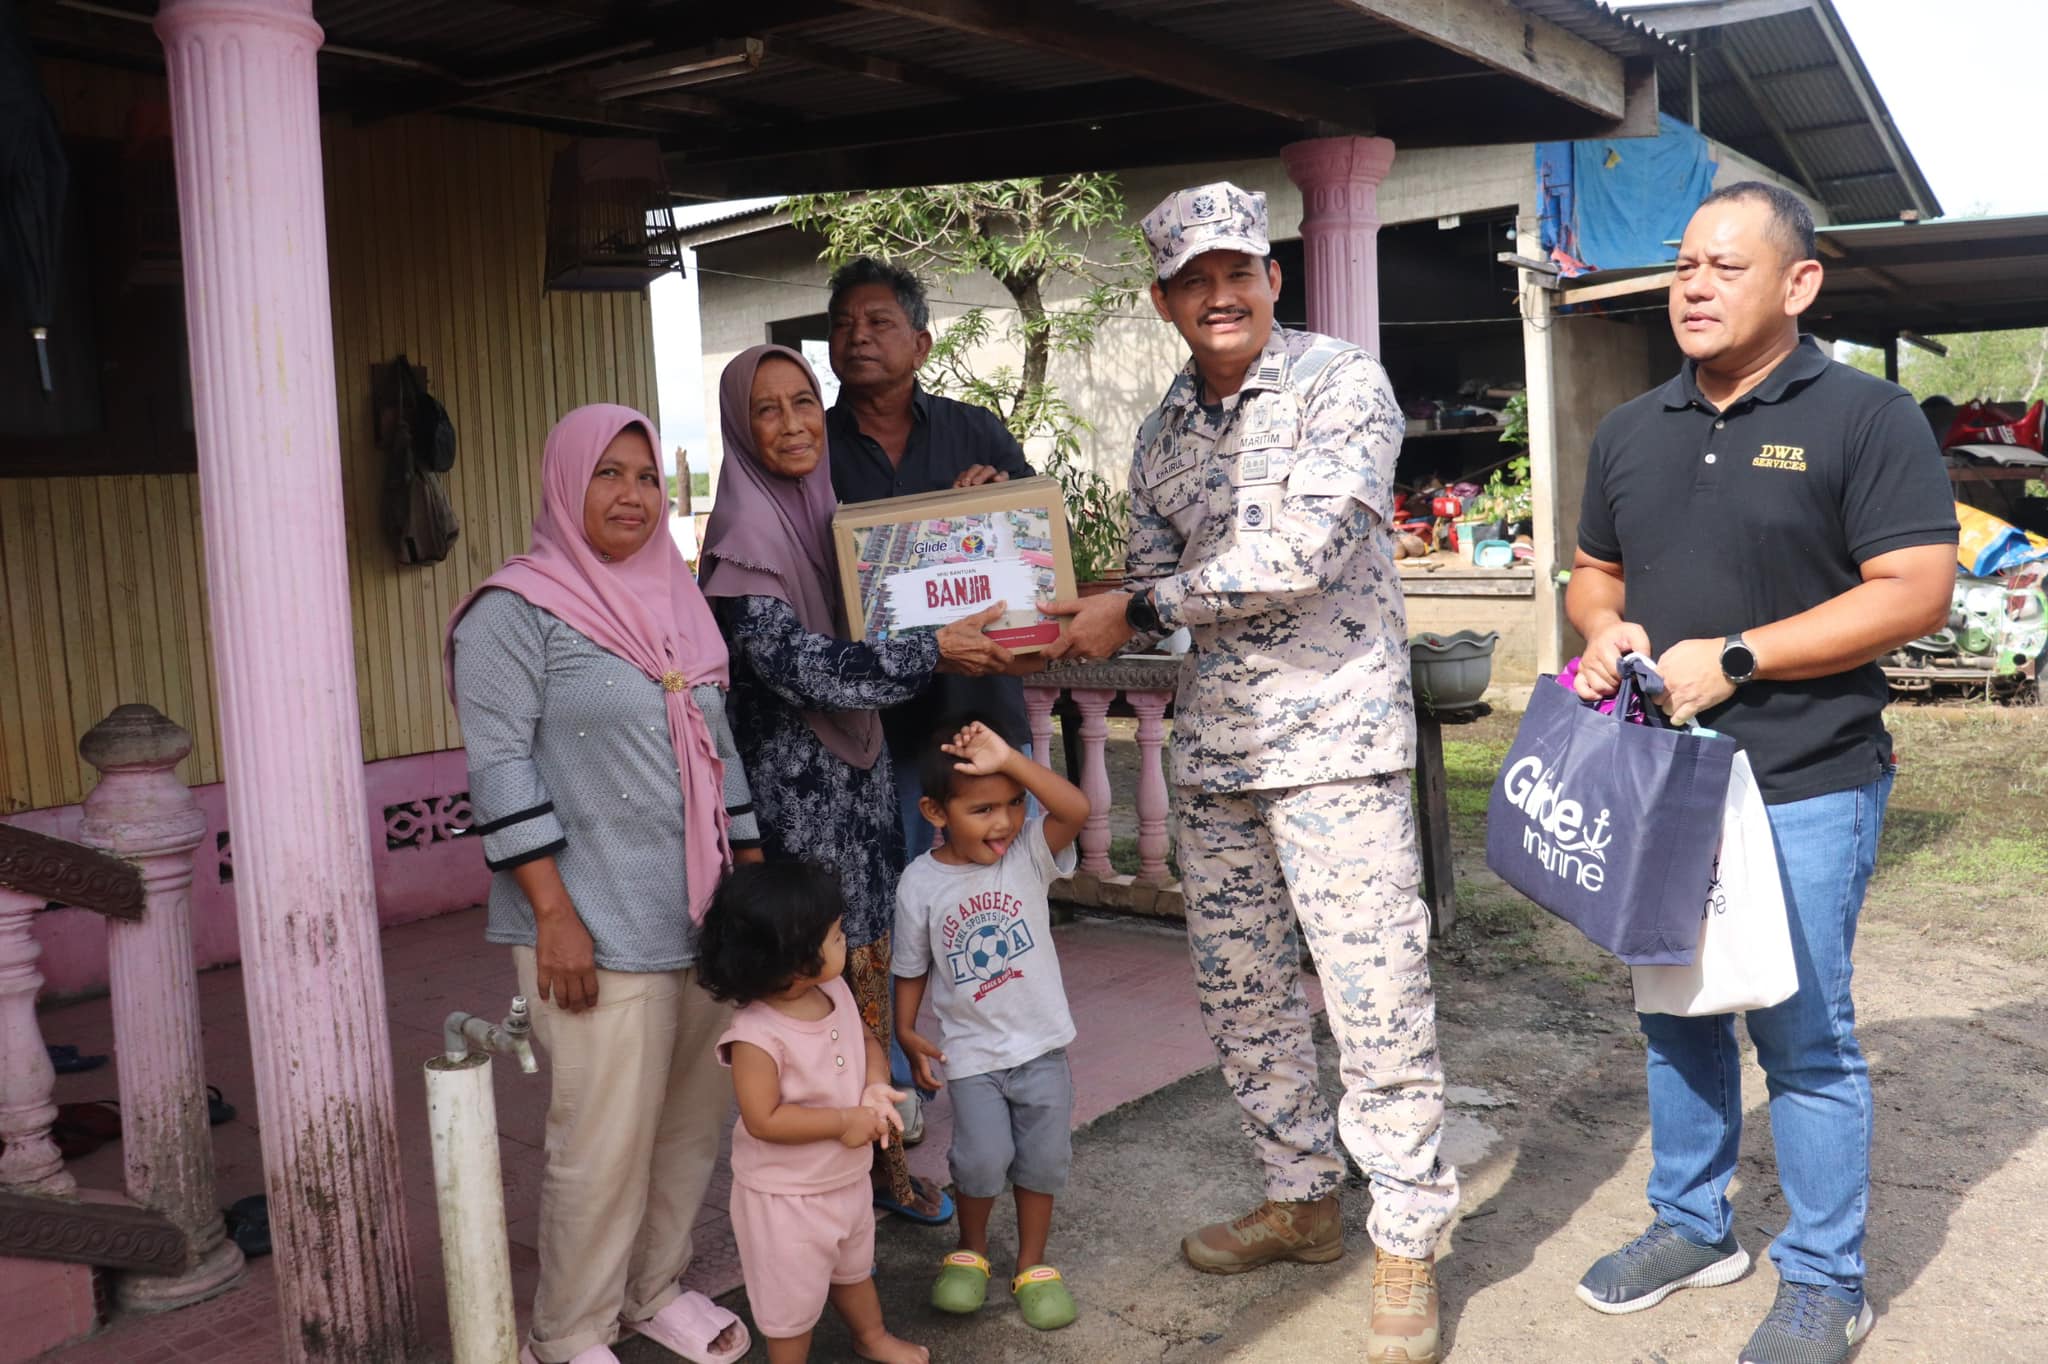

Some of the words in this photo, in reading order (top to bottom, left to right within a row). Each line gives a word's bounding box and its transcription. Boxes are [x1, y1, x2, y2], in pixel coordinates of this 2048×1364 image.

[1240, 434, 1280, 448] MARITIM
[1760, 445, 1804, 460] DWR
[1156, 458, 1186, 480] KHAIRUL
[1752, 457, 1806, 472] SERVICES
[914, 541, 947, 555] Glide
[926, 575, 992, 609] BANJIR
[1523, 825, 1604, 892] marine
[965, 912, 997, 929] SPORTS
[952, 958, 966, 980] L
[1012, 929, 1027, 951] A
